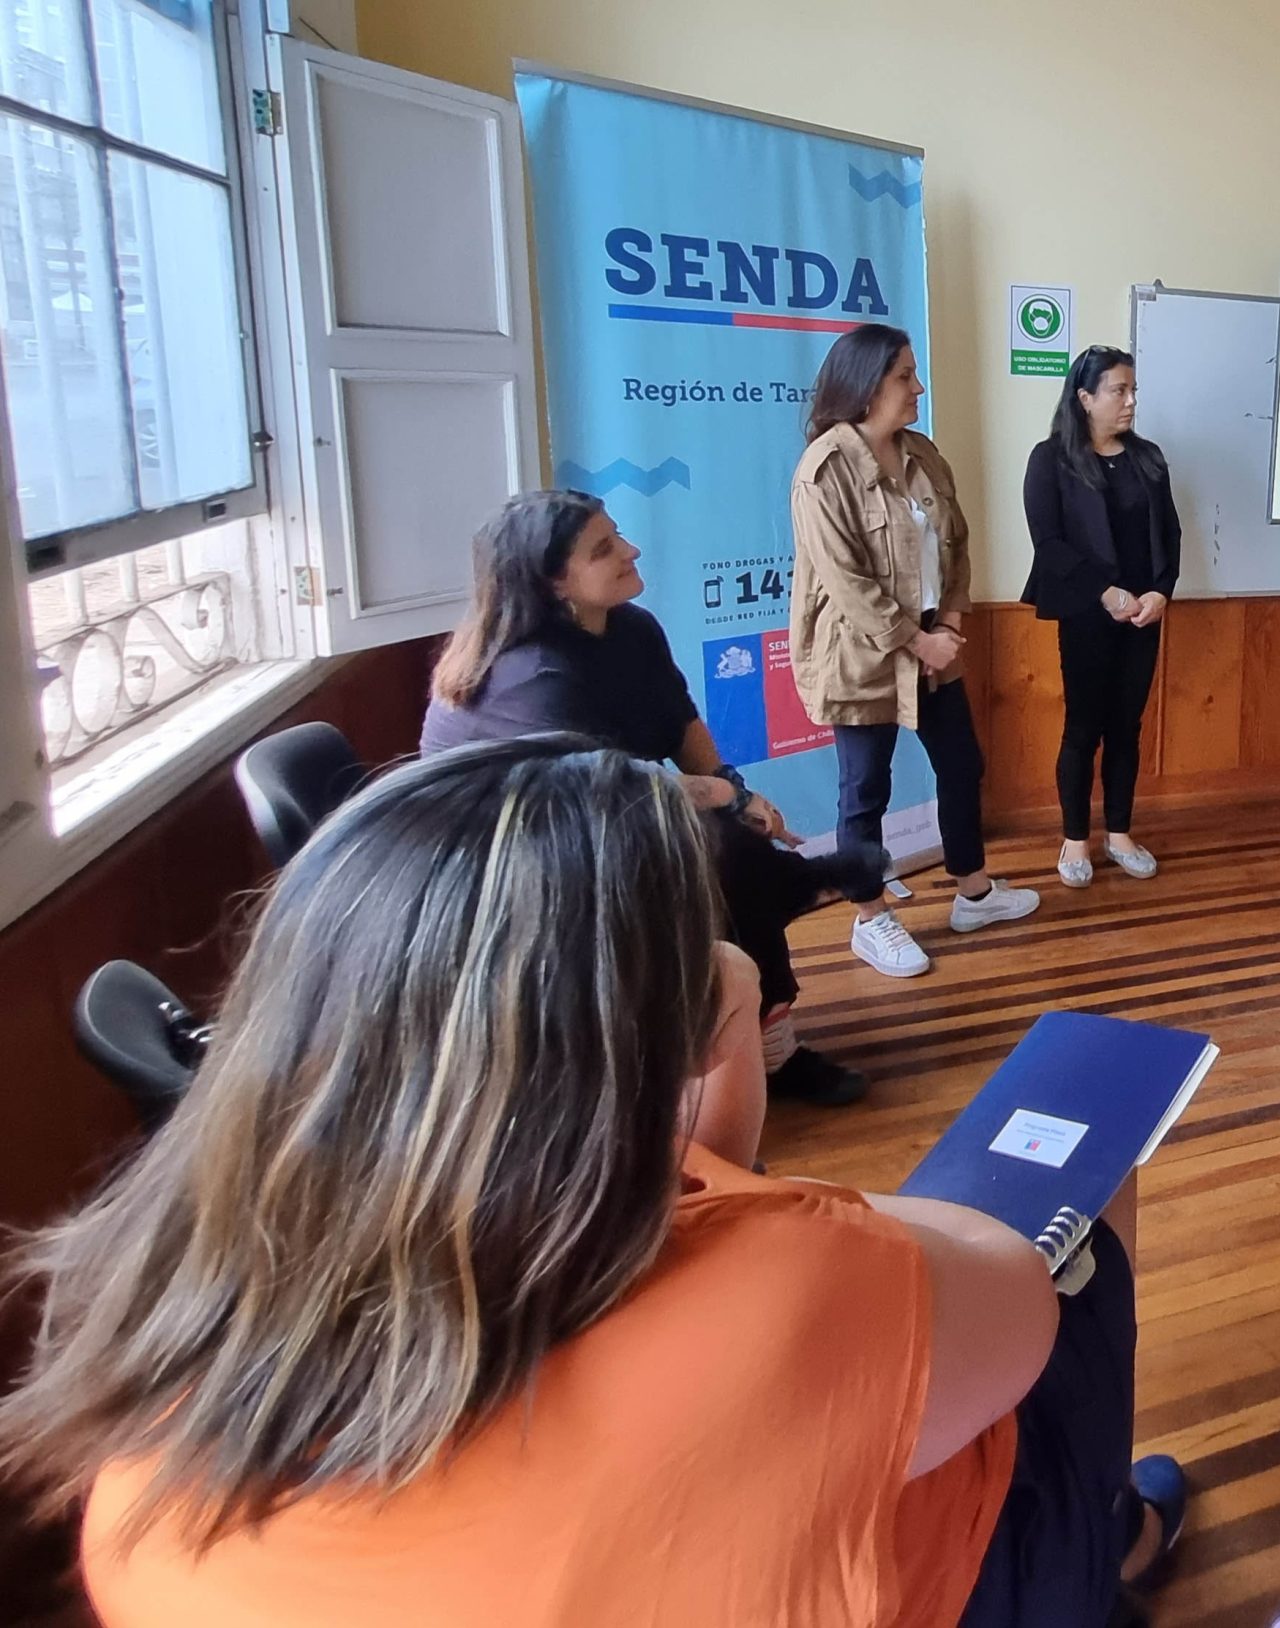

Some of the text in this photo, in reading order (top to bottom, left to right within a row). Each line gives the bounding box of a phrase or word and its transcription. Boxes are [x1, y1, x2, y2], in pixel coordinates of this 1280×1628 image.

[605, 227, 888, 315] SENDA
[623, 378, 817, 407] Región de Tara
[702, 561, 731, 570] FONO
[736, 557, 775, 568] DROGAS
[768, 640, 789, 651] SEN
